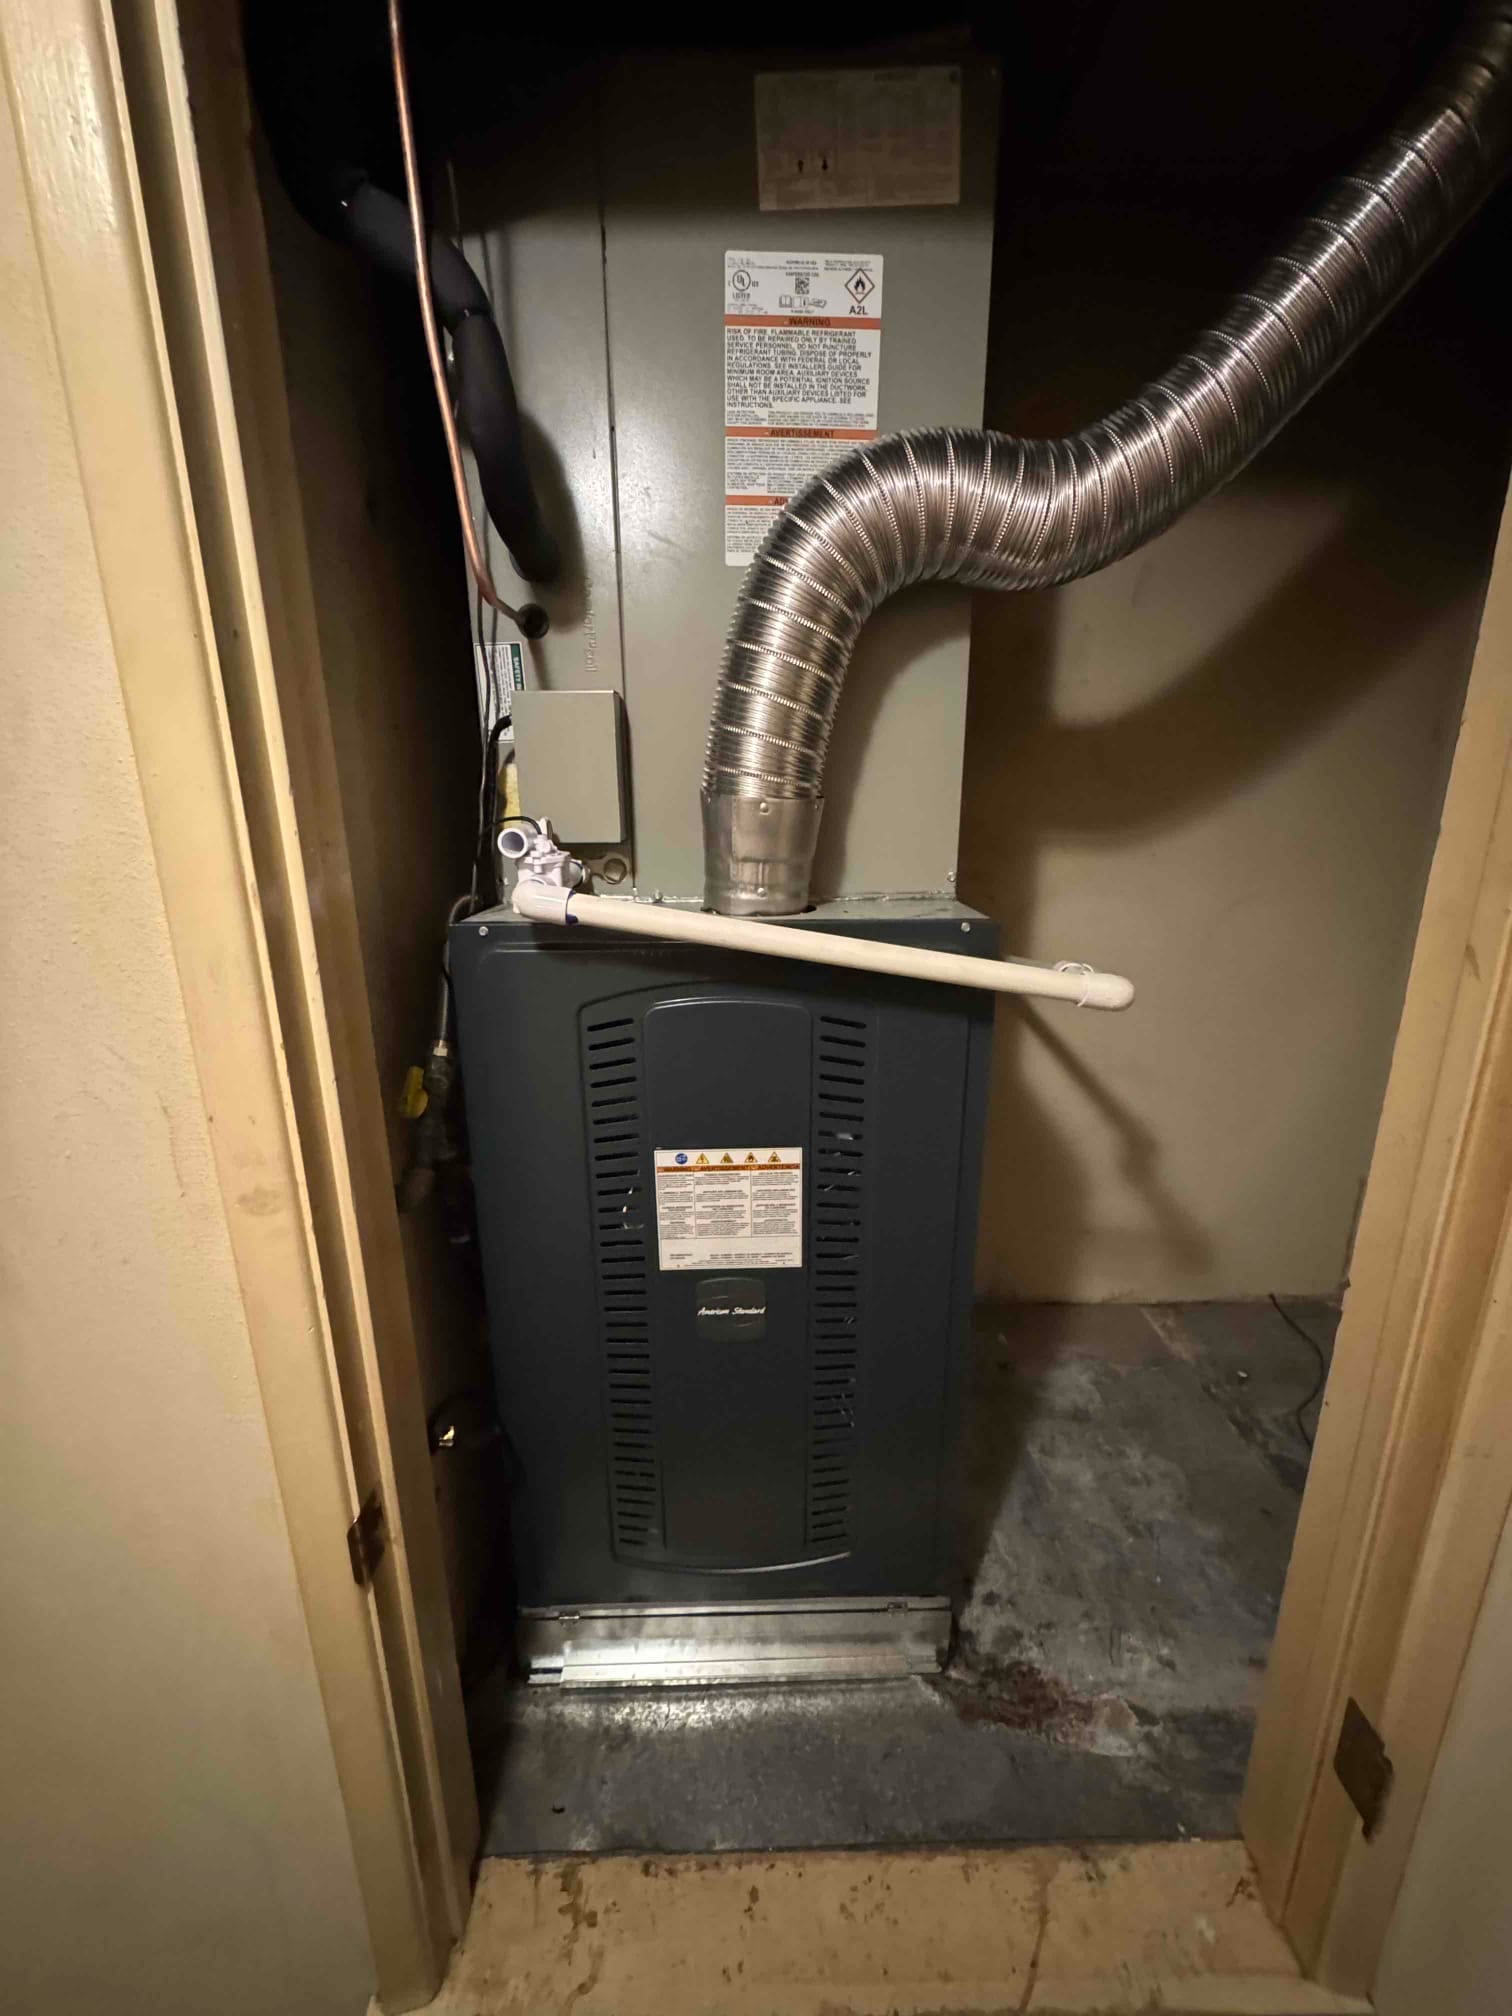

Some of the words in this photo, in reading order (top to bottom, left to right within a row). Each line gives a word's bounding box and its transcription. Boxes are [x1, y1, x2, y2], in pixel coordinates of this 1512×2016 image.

[849, 306, 868, 315] A2L
[788, 318, 831, 327] WARNING
[770, 428, 835, 438] AVERTISSEMENT
[513, 656, 522, 681] SAFETY
[697, 1306, 730, 1316] American
[731, 1306, 766, 1315] Standard
